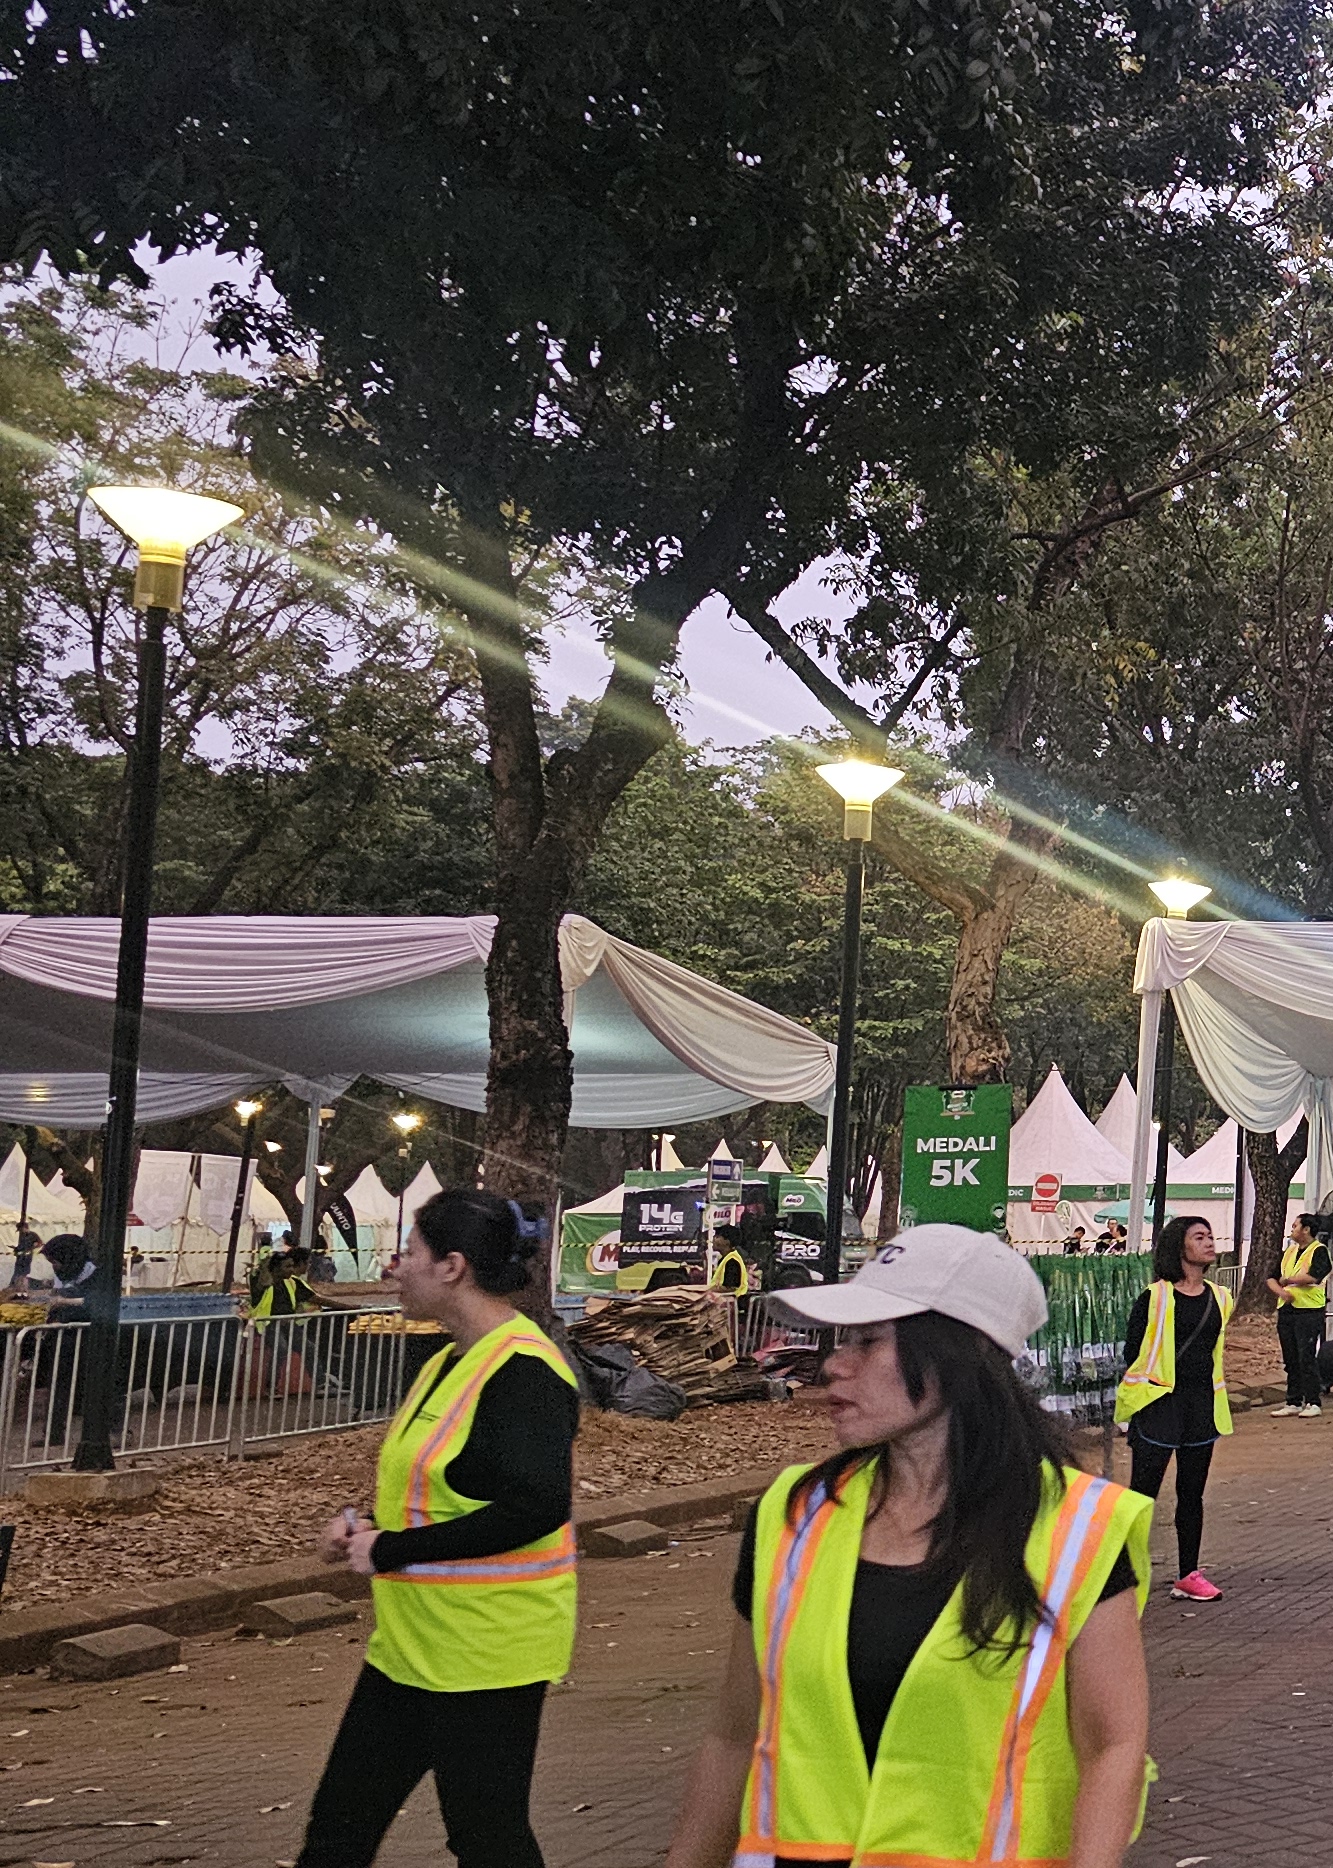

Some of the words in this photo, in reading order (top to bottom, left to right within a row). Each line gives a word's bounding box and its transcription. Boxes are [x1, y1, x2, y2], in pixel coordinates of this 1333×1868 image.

[916, 1136, 997, 1153] MEDALI
[929, 1158, 980, 1187] 5K
[640, 1203, 684, 1224] 14G
[638, 1224, 684, 1232] PROTEIN
[781, 1244, 821, 1258] PRO
